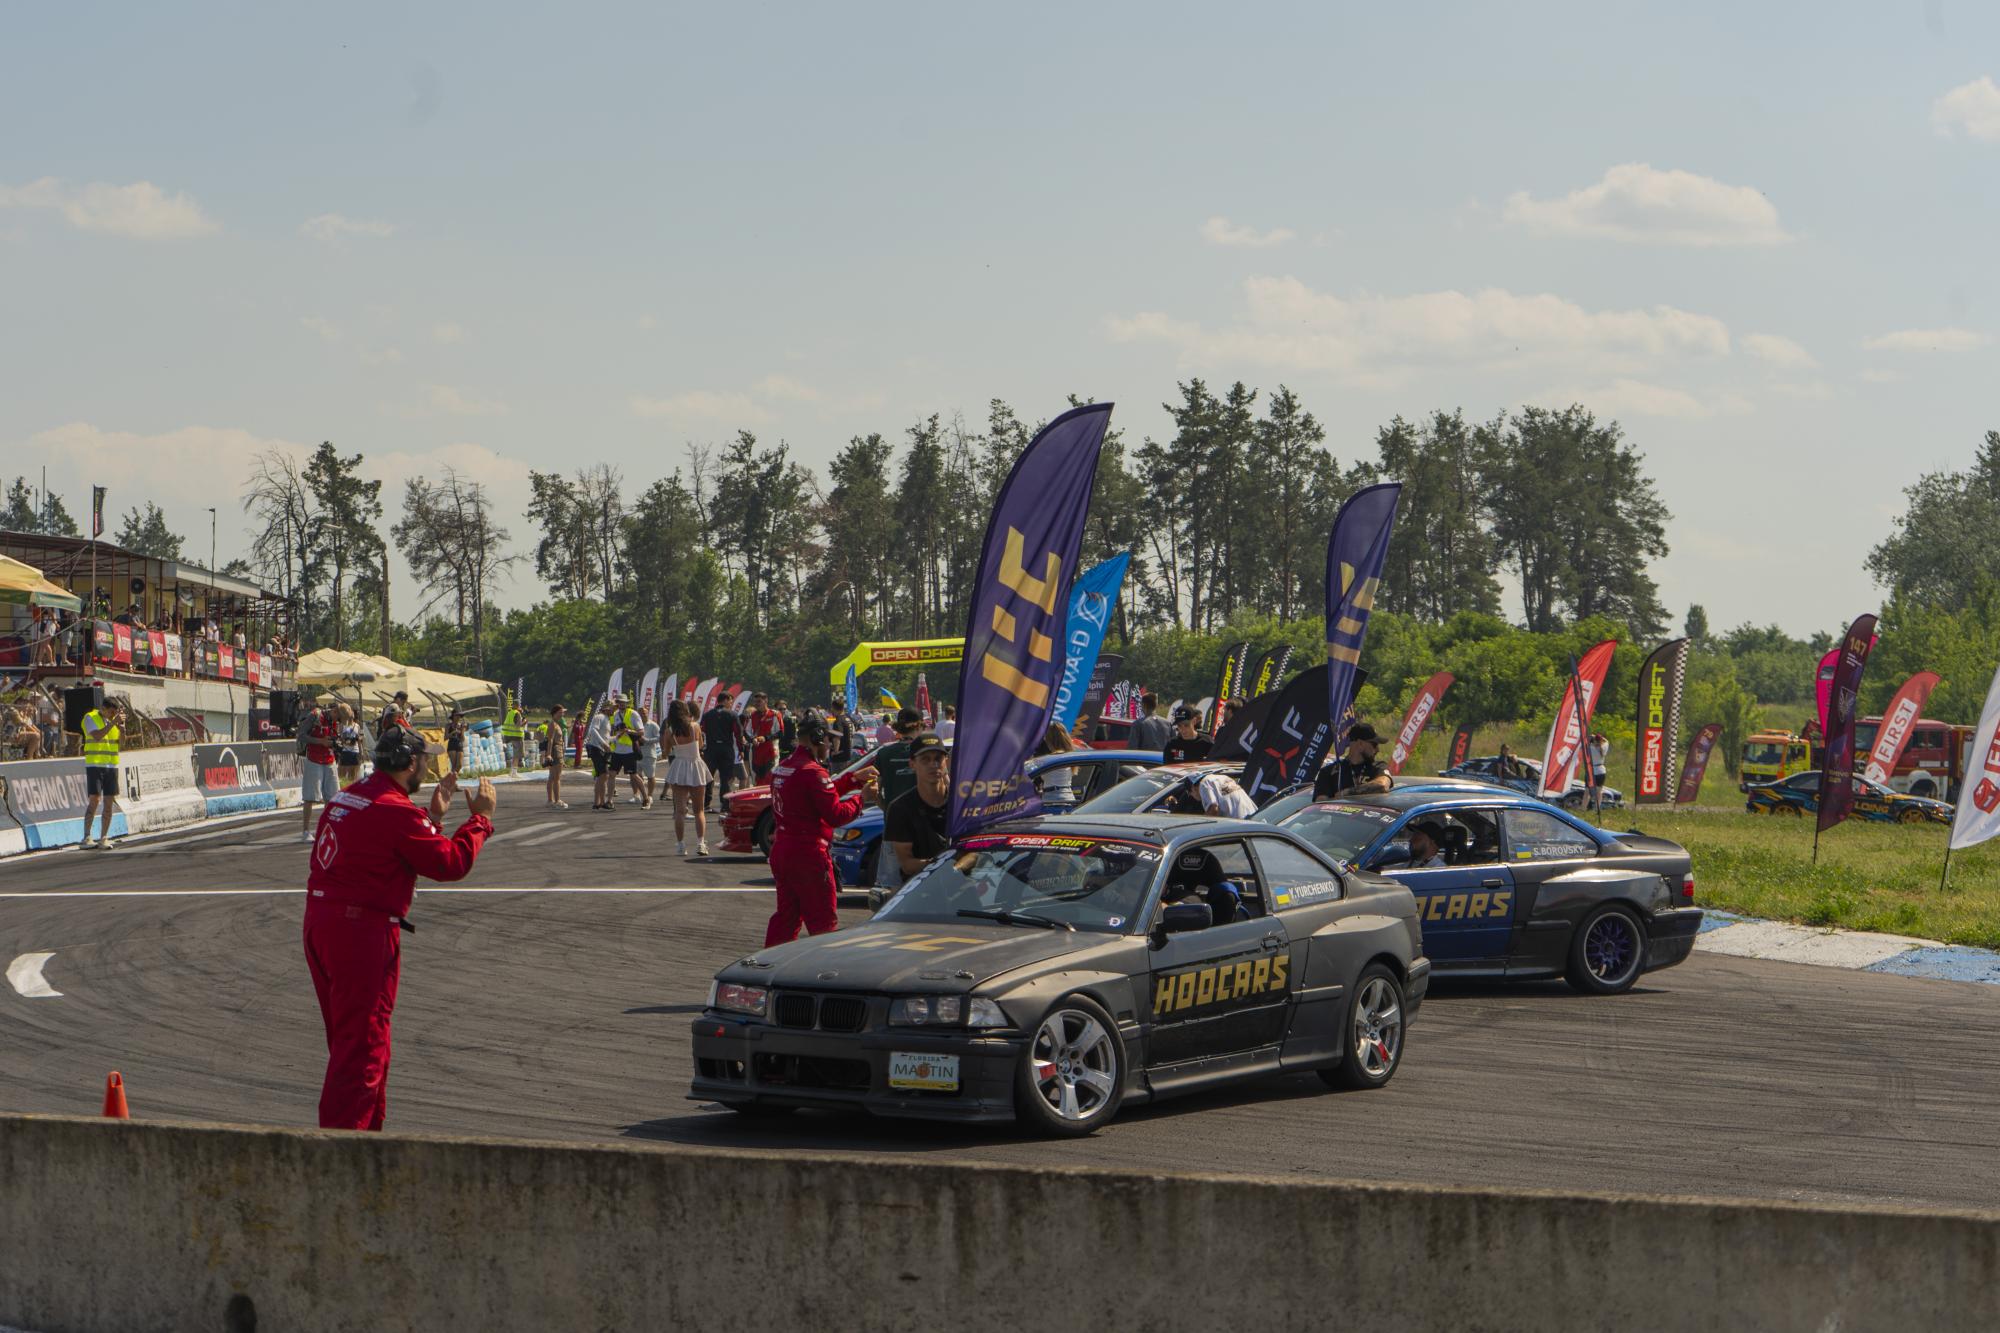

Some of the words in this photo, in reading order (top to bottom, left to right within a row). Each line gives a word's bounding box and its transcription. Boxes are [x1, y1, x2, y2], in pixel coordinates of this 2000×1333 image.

[873, 649, 918, 660] OPEN
[920, 647, 964, 659] DRIFT
[1403, 697, 1432, 742] FIRST
[1649, 662, 1666, 728] DRIFT
[1879, 703, 1913, 758] FIRST
[1643, 730, 1662, 793] OPEN
[11, 776, 70, 814] РОБИМО
[1010, 837, 1049, 846] OPEN
[1050, 838, 1096, 848] DRIFT
[1153, 955, 1289, 1014] HOOCARS
